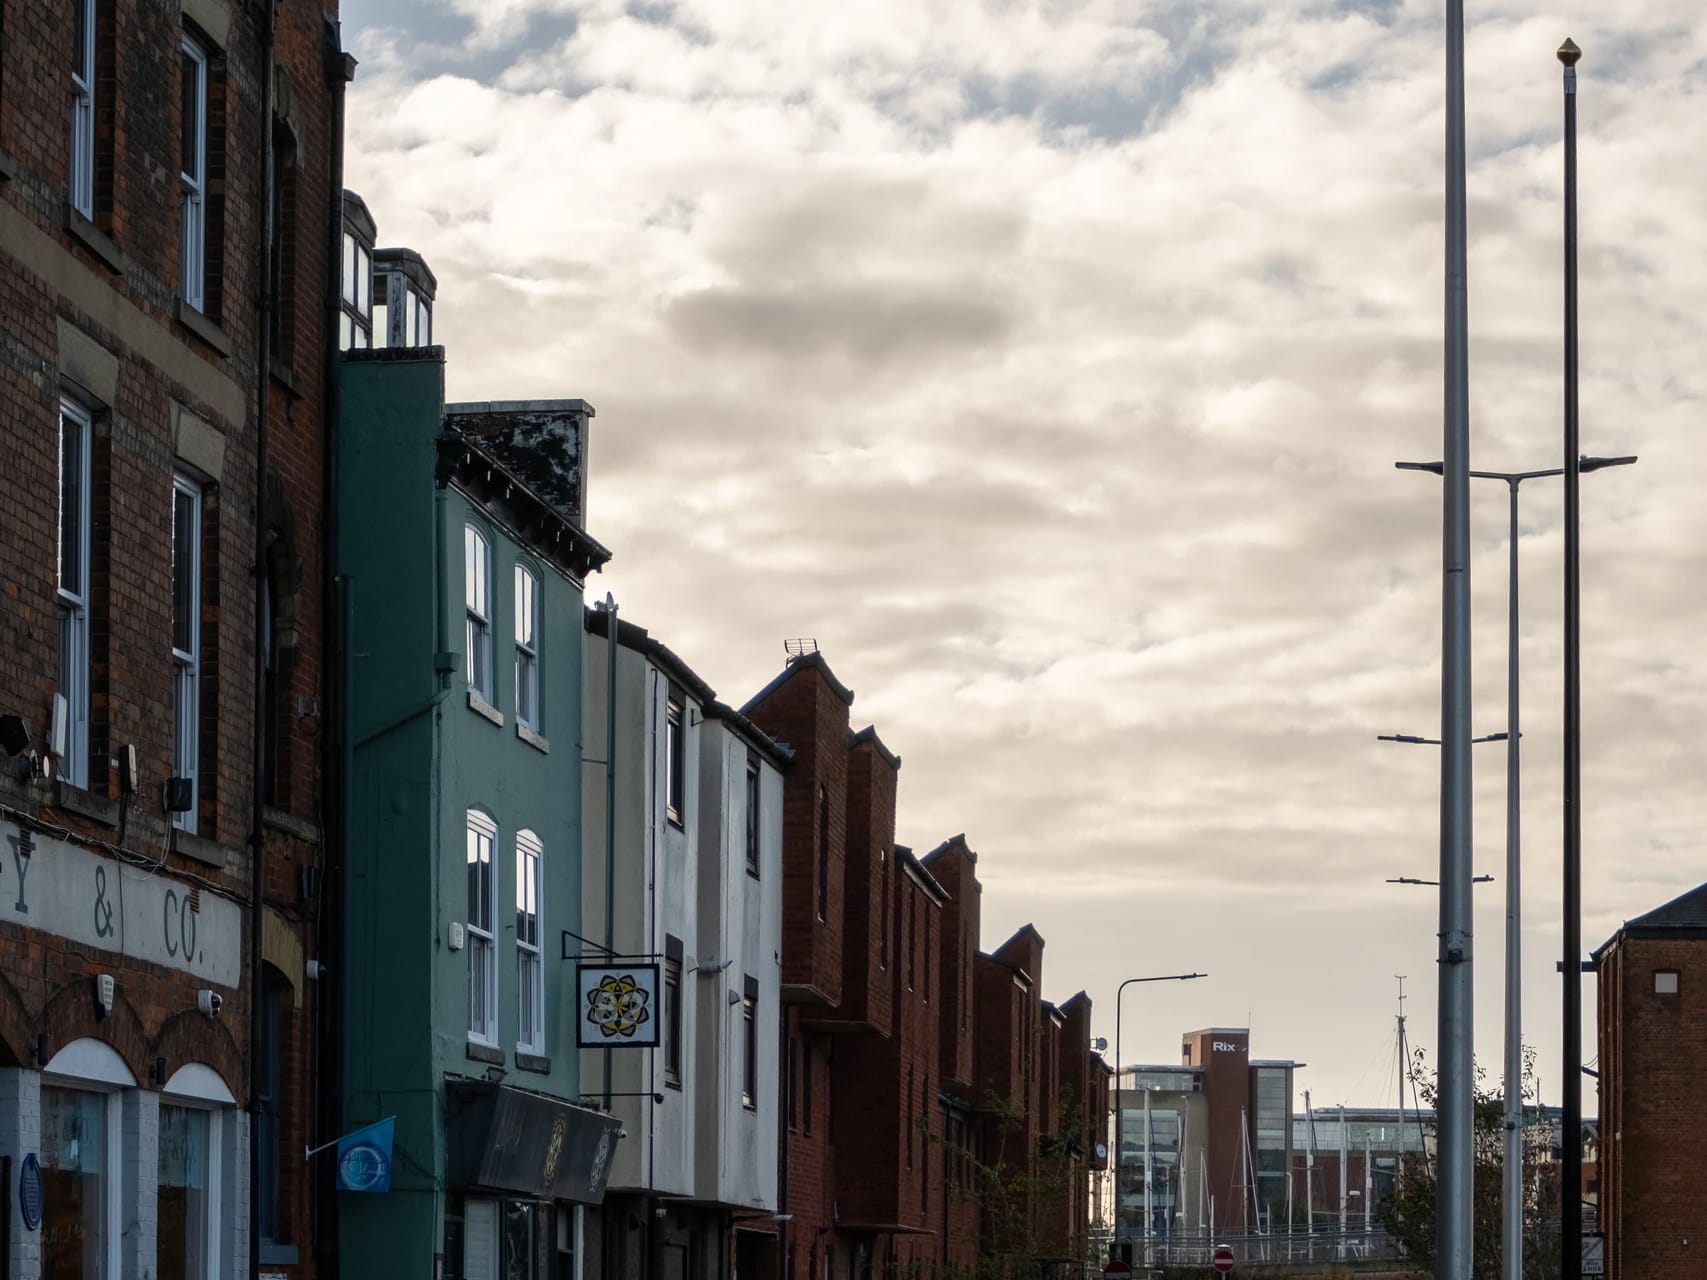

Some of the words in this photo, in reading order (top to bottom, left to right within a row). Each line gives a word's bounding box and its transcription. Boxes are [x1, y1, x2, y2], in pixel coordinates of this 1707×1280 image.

[0, 834, 37, 914] Y
[94, 865, 114, 938] &
[1212, 1041, 1236, 1052] Rix
